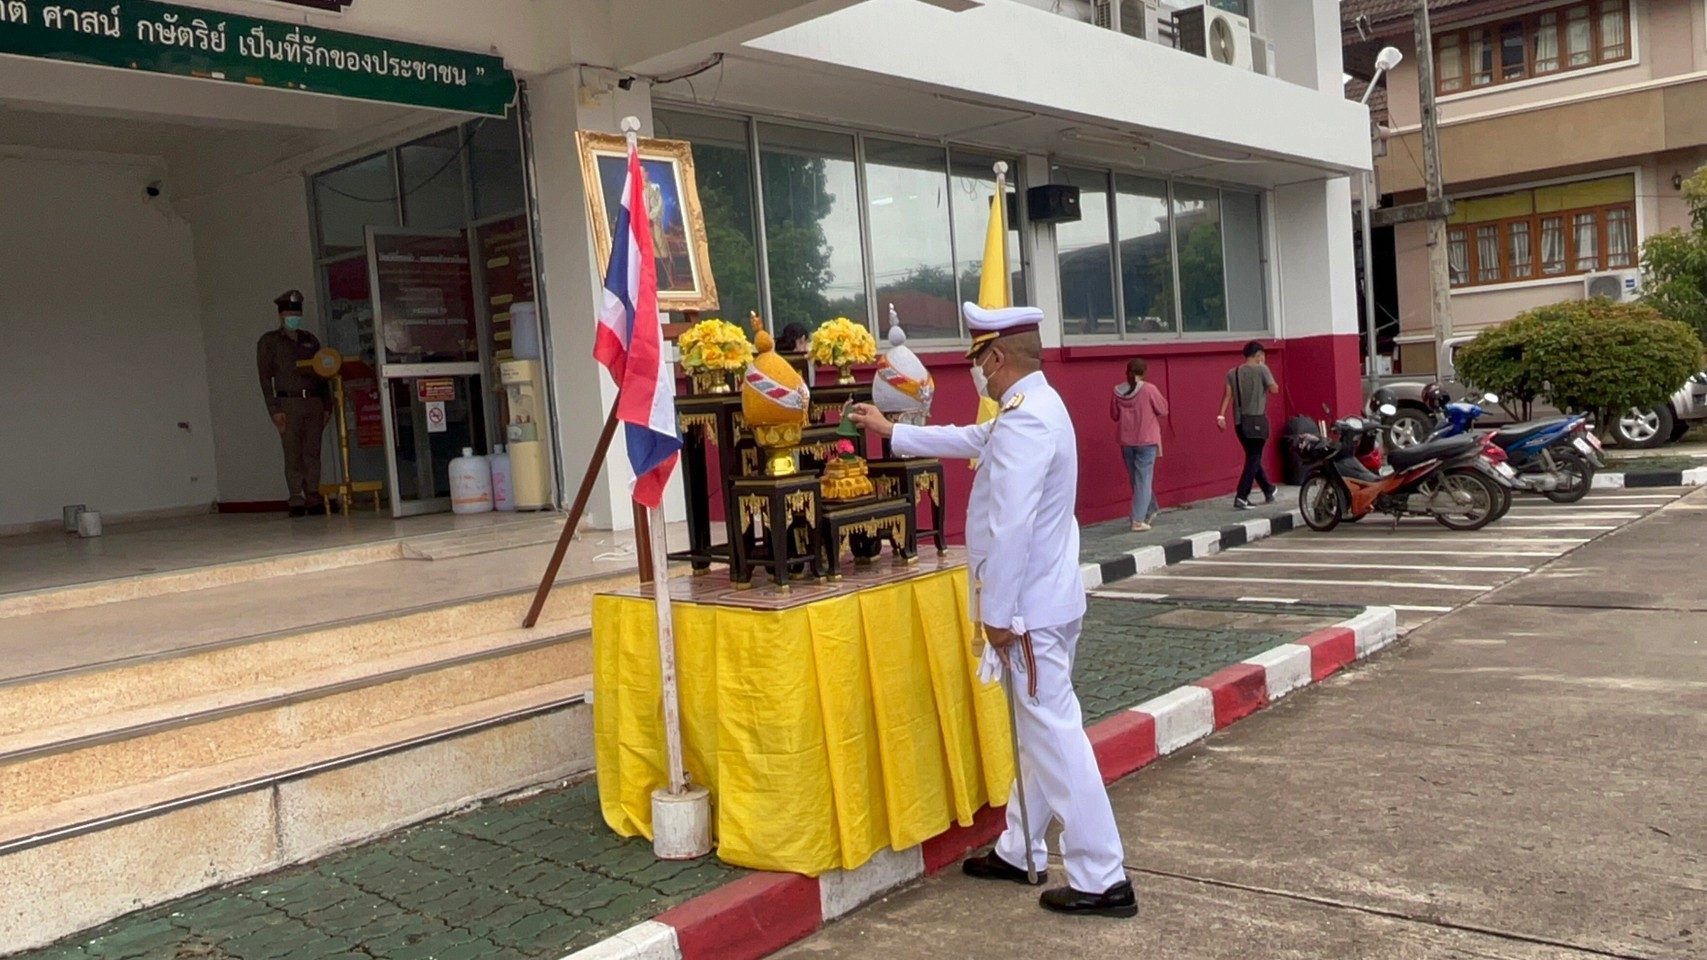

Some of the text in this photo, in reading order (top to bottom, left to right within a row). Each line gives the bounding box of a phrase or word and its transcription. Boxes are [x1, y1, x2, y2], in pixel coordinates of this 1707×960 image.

[43, 5, 121, 38] ศาสน์
[137, 12, 226, 53] กษัตริย์
[238, 26, 467, 86] เป็นที่รักของประชาชน
